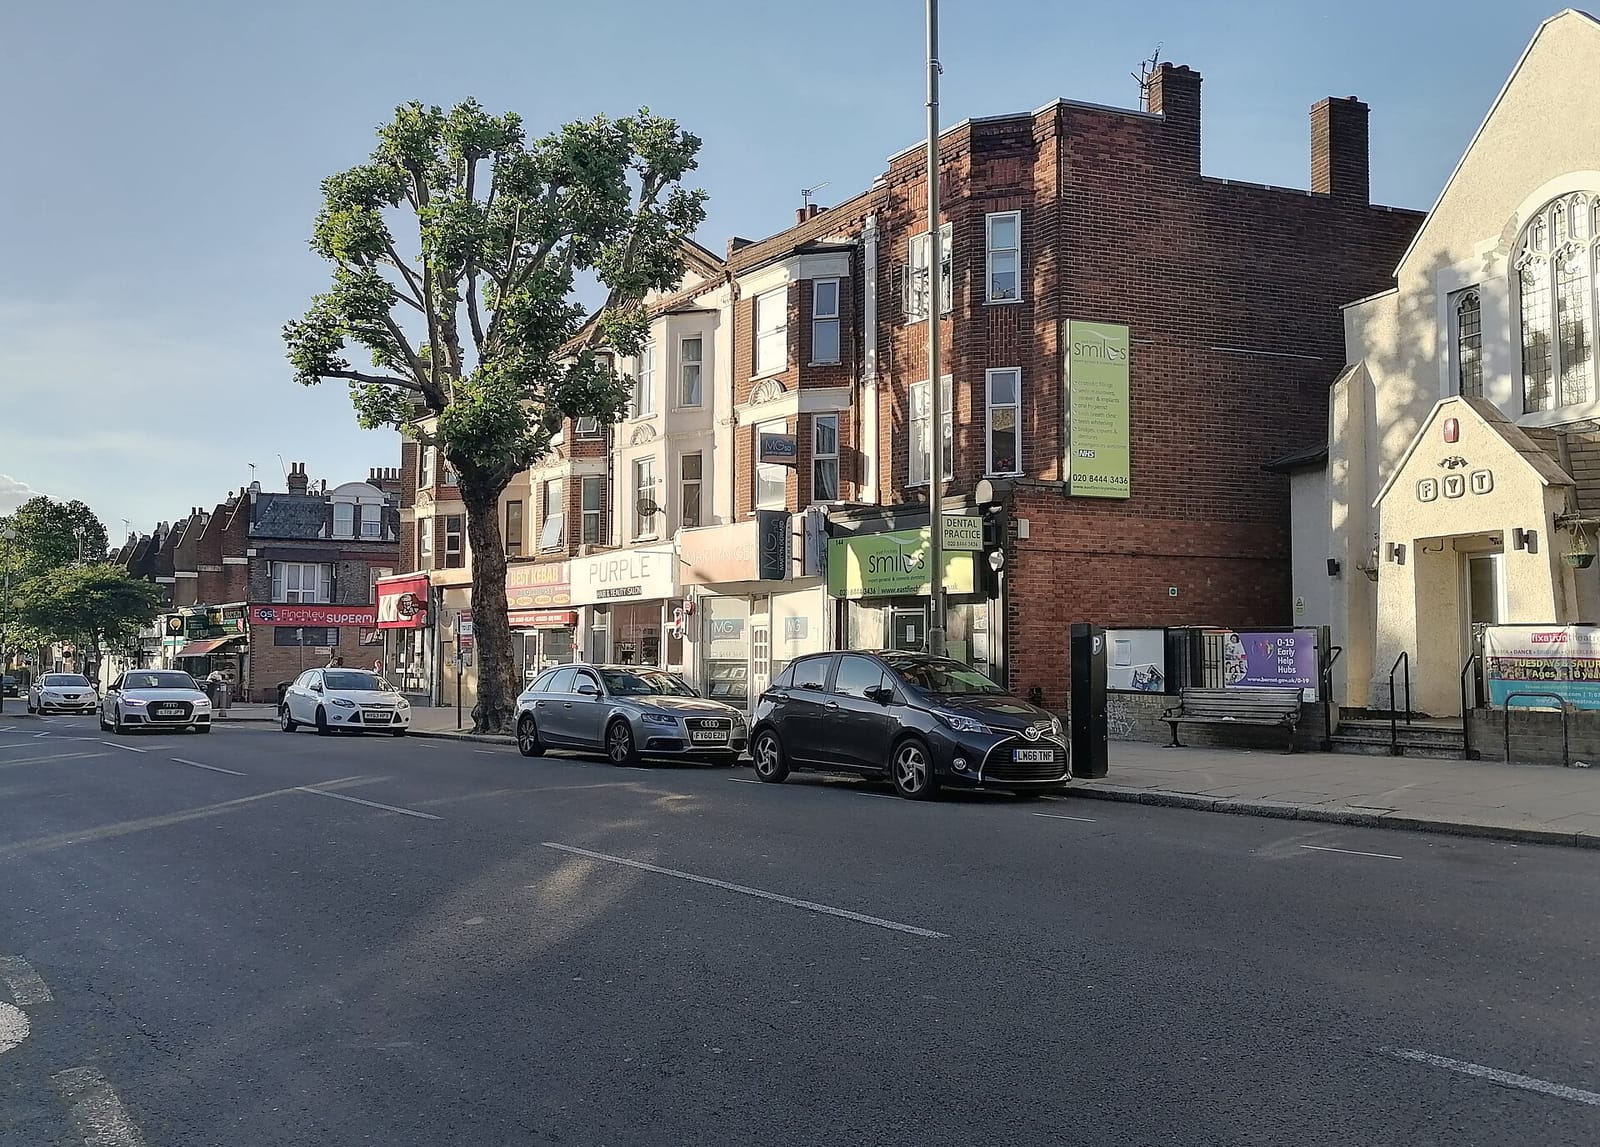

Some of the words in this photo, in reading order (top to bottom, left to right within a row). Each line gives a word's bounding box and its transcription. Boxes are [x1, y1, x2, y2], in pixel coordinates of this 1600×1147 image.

[1079, 449, 1095, 458] NHS
[1089, 475, 1107, 483] 8444
[1110, 476, 1128, 484] 3436
[946, 519, 977, 528] DENTAL
[944, 529, 981, 539] PRACTICE
[589, 556, 650, 584] PURPLE
[531, 566, 559, 584] KEBAB
[864, 587, 876, 595] 3436
[254, 608, 278, 619] East
[281, 609, 325, 620] Finchley
[713, 621, 734, 633] MG
[787, 619, 801, 632] MG
[1277, 638, 1295, 646] 0-19
[1532, 633, 1567, 643] fixation
[1277, 648, 1295, 657] Early
[1277, 657, 1293, 665] Help
[1515, 659, 1559, 668] TUESDAYS
[1278, 665, 1296, 674] Hubs
[1532, 670, 1555, 679] Ages
